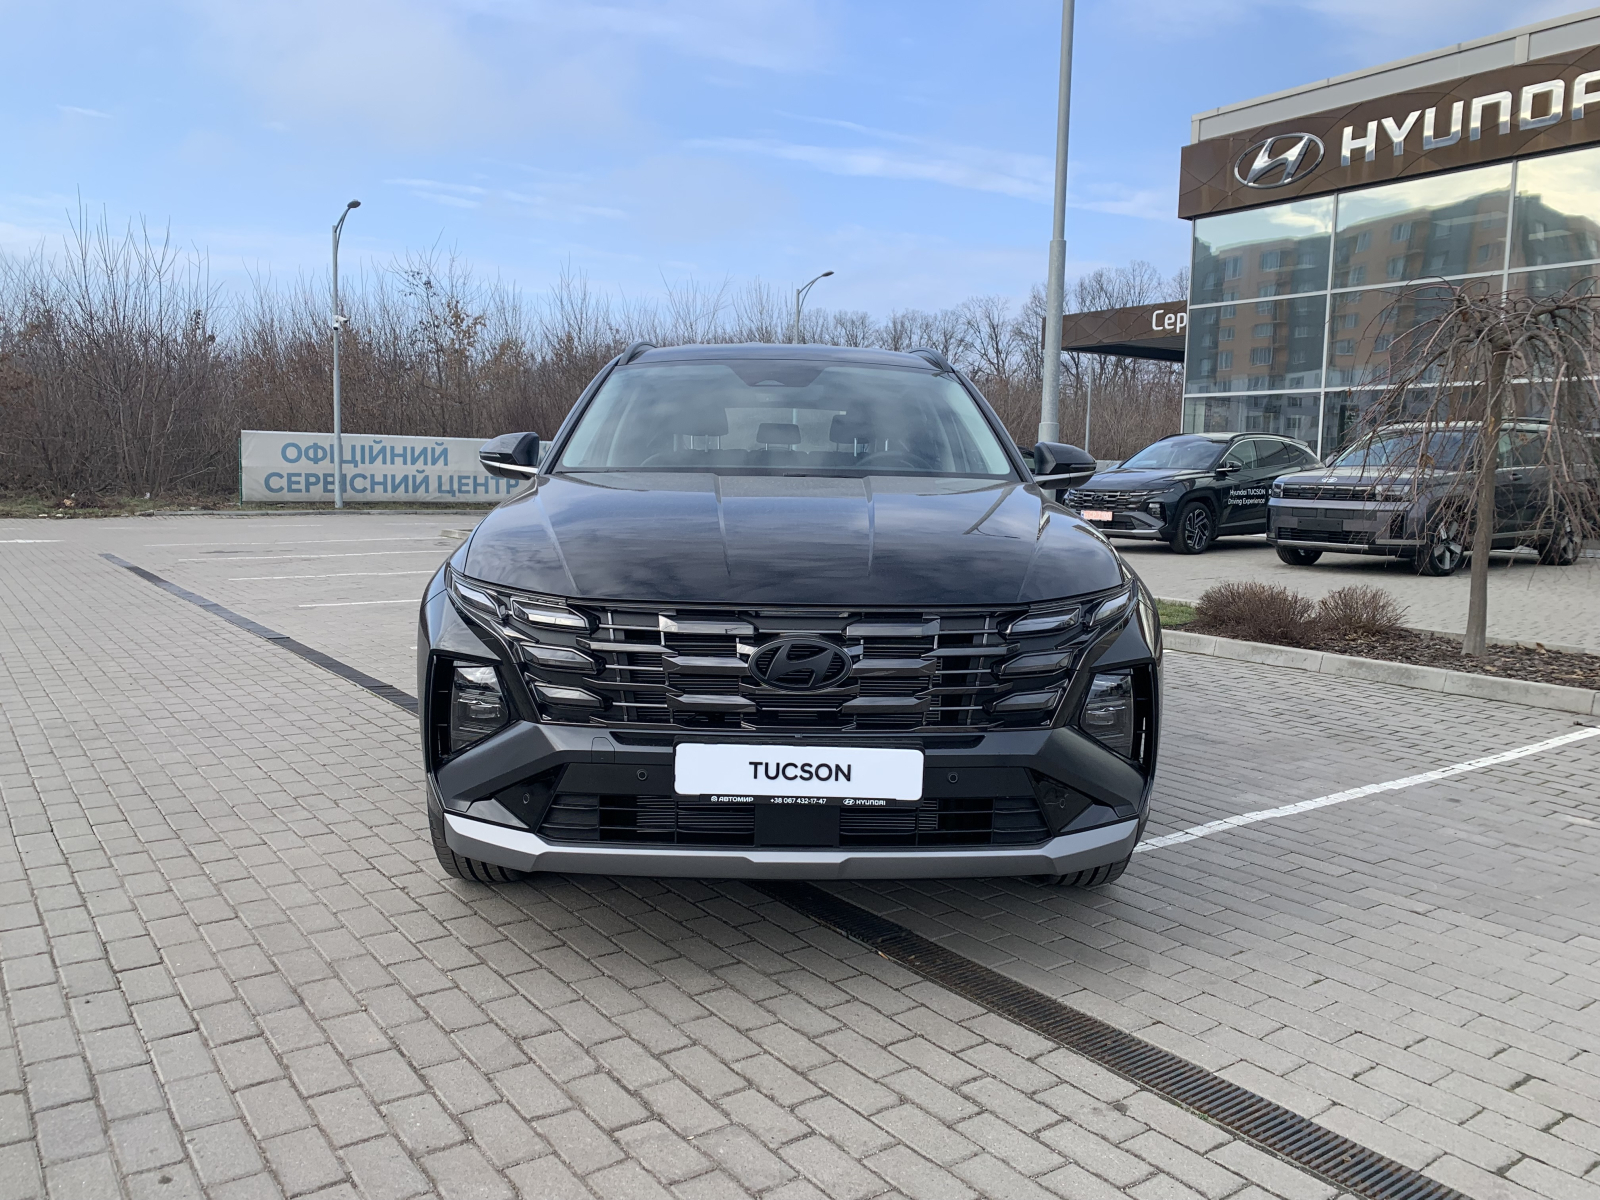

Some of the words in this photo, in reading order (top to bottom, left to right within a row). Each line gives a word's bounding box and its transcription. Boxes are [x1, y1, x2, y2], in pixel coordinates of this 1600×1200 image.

[281, 439, 448, 469] ОФІЦІЙНИЙ
[264, 469, 430, 494] СЕРВІСНИЙ
[437, 475, 519, 497] ЦЕНТР
[1230, 489, 1247, 497] Hyundai
[1242, 497, 1265, 505] Experience
[749, 761, 851, 781] TUCSON
